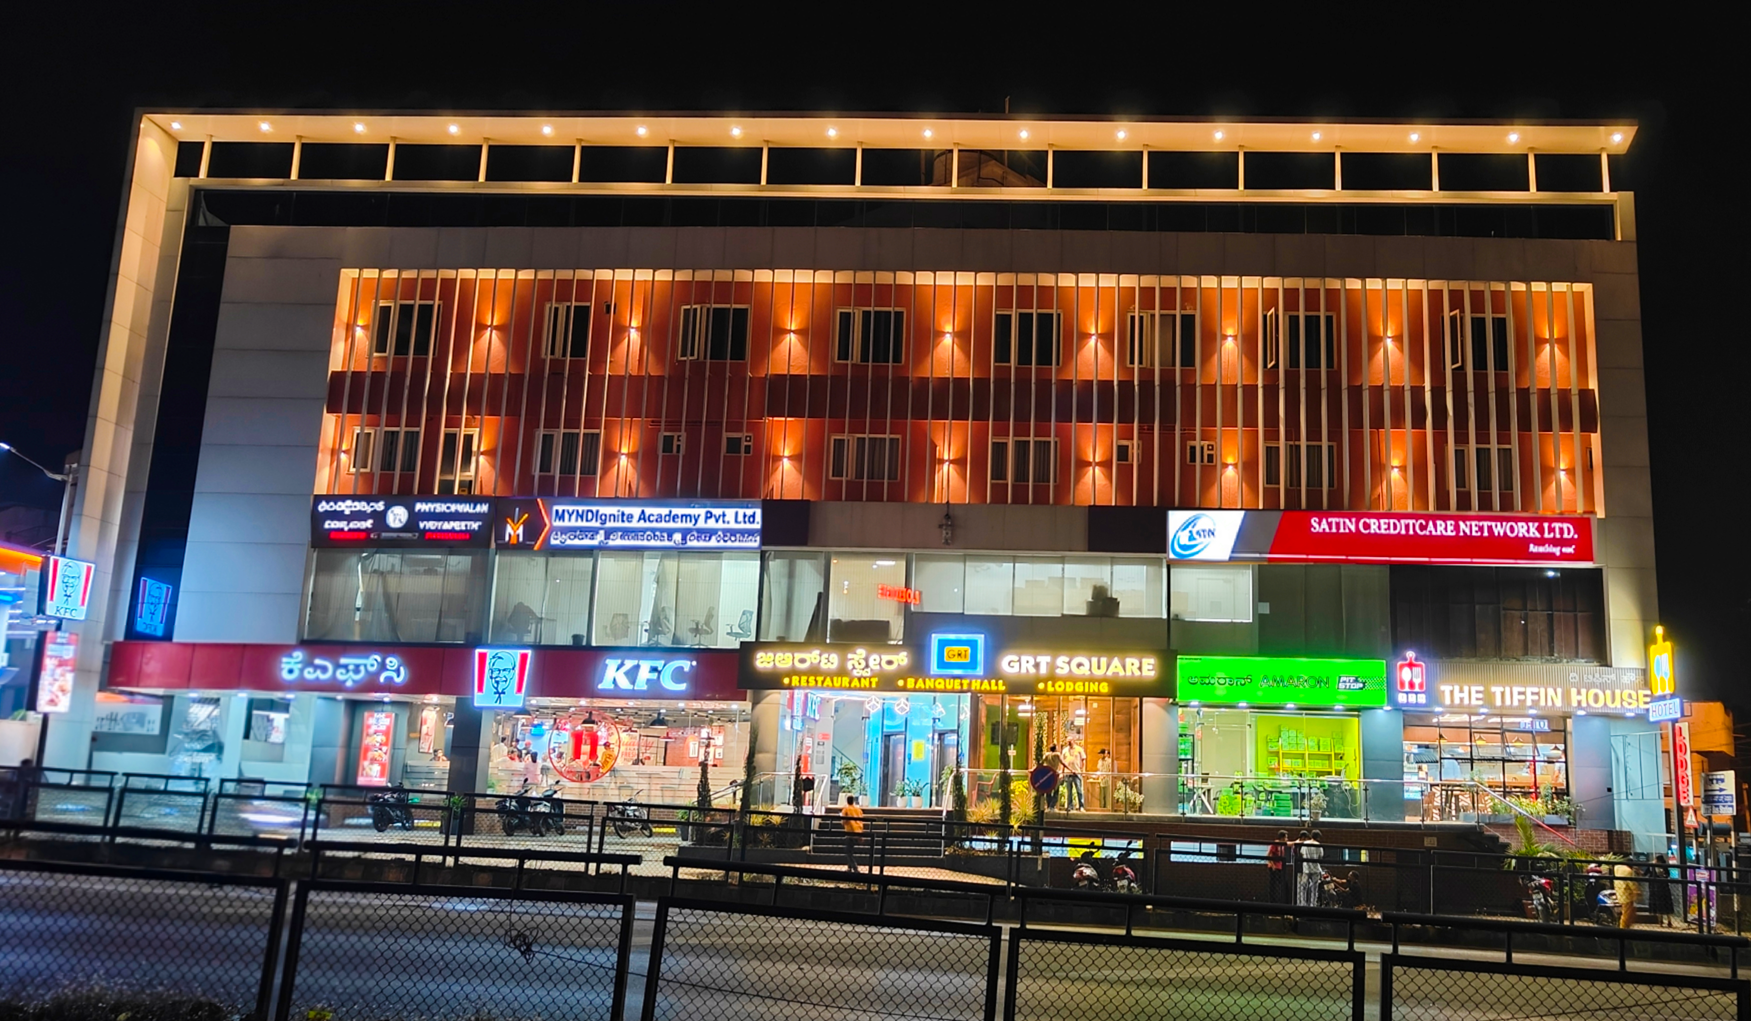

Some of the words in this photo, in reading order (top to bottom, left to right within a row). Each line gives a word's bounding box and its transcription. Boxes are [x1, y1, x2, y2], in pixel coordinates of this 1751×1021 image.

[553, 508, 634, 526] MYNDIgnite
[637, 509, 701, 527] Academy
[704, 510, 730, 525] Pvt.
[734, 510, 760, 525] Ltd.
[1310, 517, 1356, 533] SATIN
[1358, 518, 1456, 537] CREDITCARE
[1458, 520, 1541, 538] NETWORK
[1543, 522, 1578, 539] LTD.
[54, 606, 77, 618] KFC
[946, 649, 969, 660] GRT
[598, 659, 691, 690] KFC
[1001, 655, 1051, 674] GRT
[1055, 656, 1156, 677] SQUARE
[791, 675, 879, 689] RESTAURANT
[1047, 681, 1109, 693] LODGING
[1259, 675, 1331, 689] AMARON
[1440, 684, 1485, 706] THE
[1490, 685, 1562, 708] TIFFIN
[1571, 688, 1651, 710] HOUSE
[1651, 702, 1678, 718] HOTEL
[1675, 724, 1694, 805] LODGE
